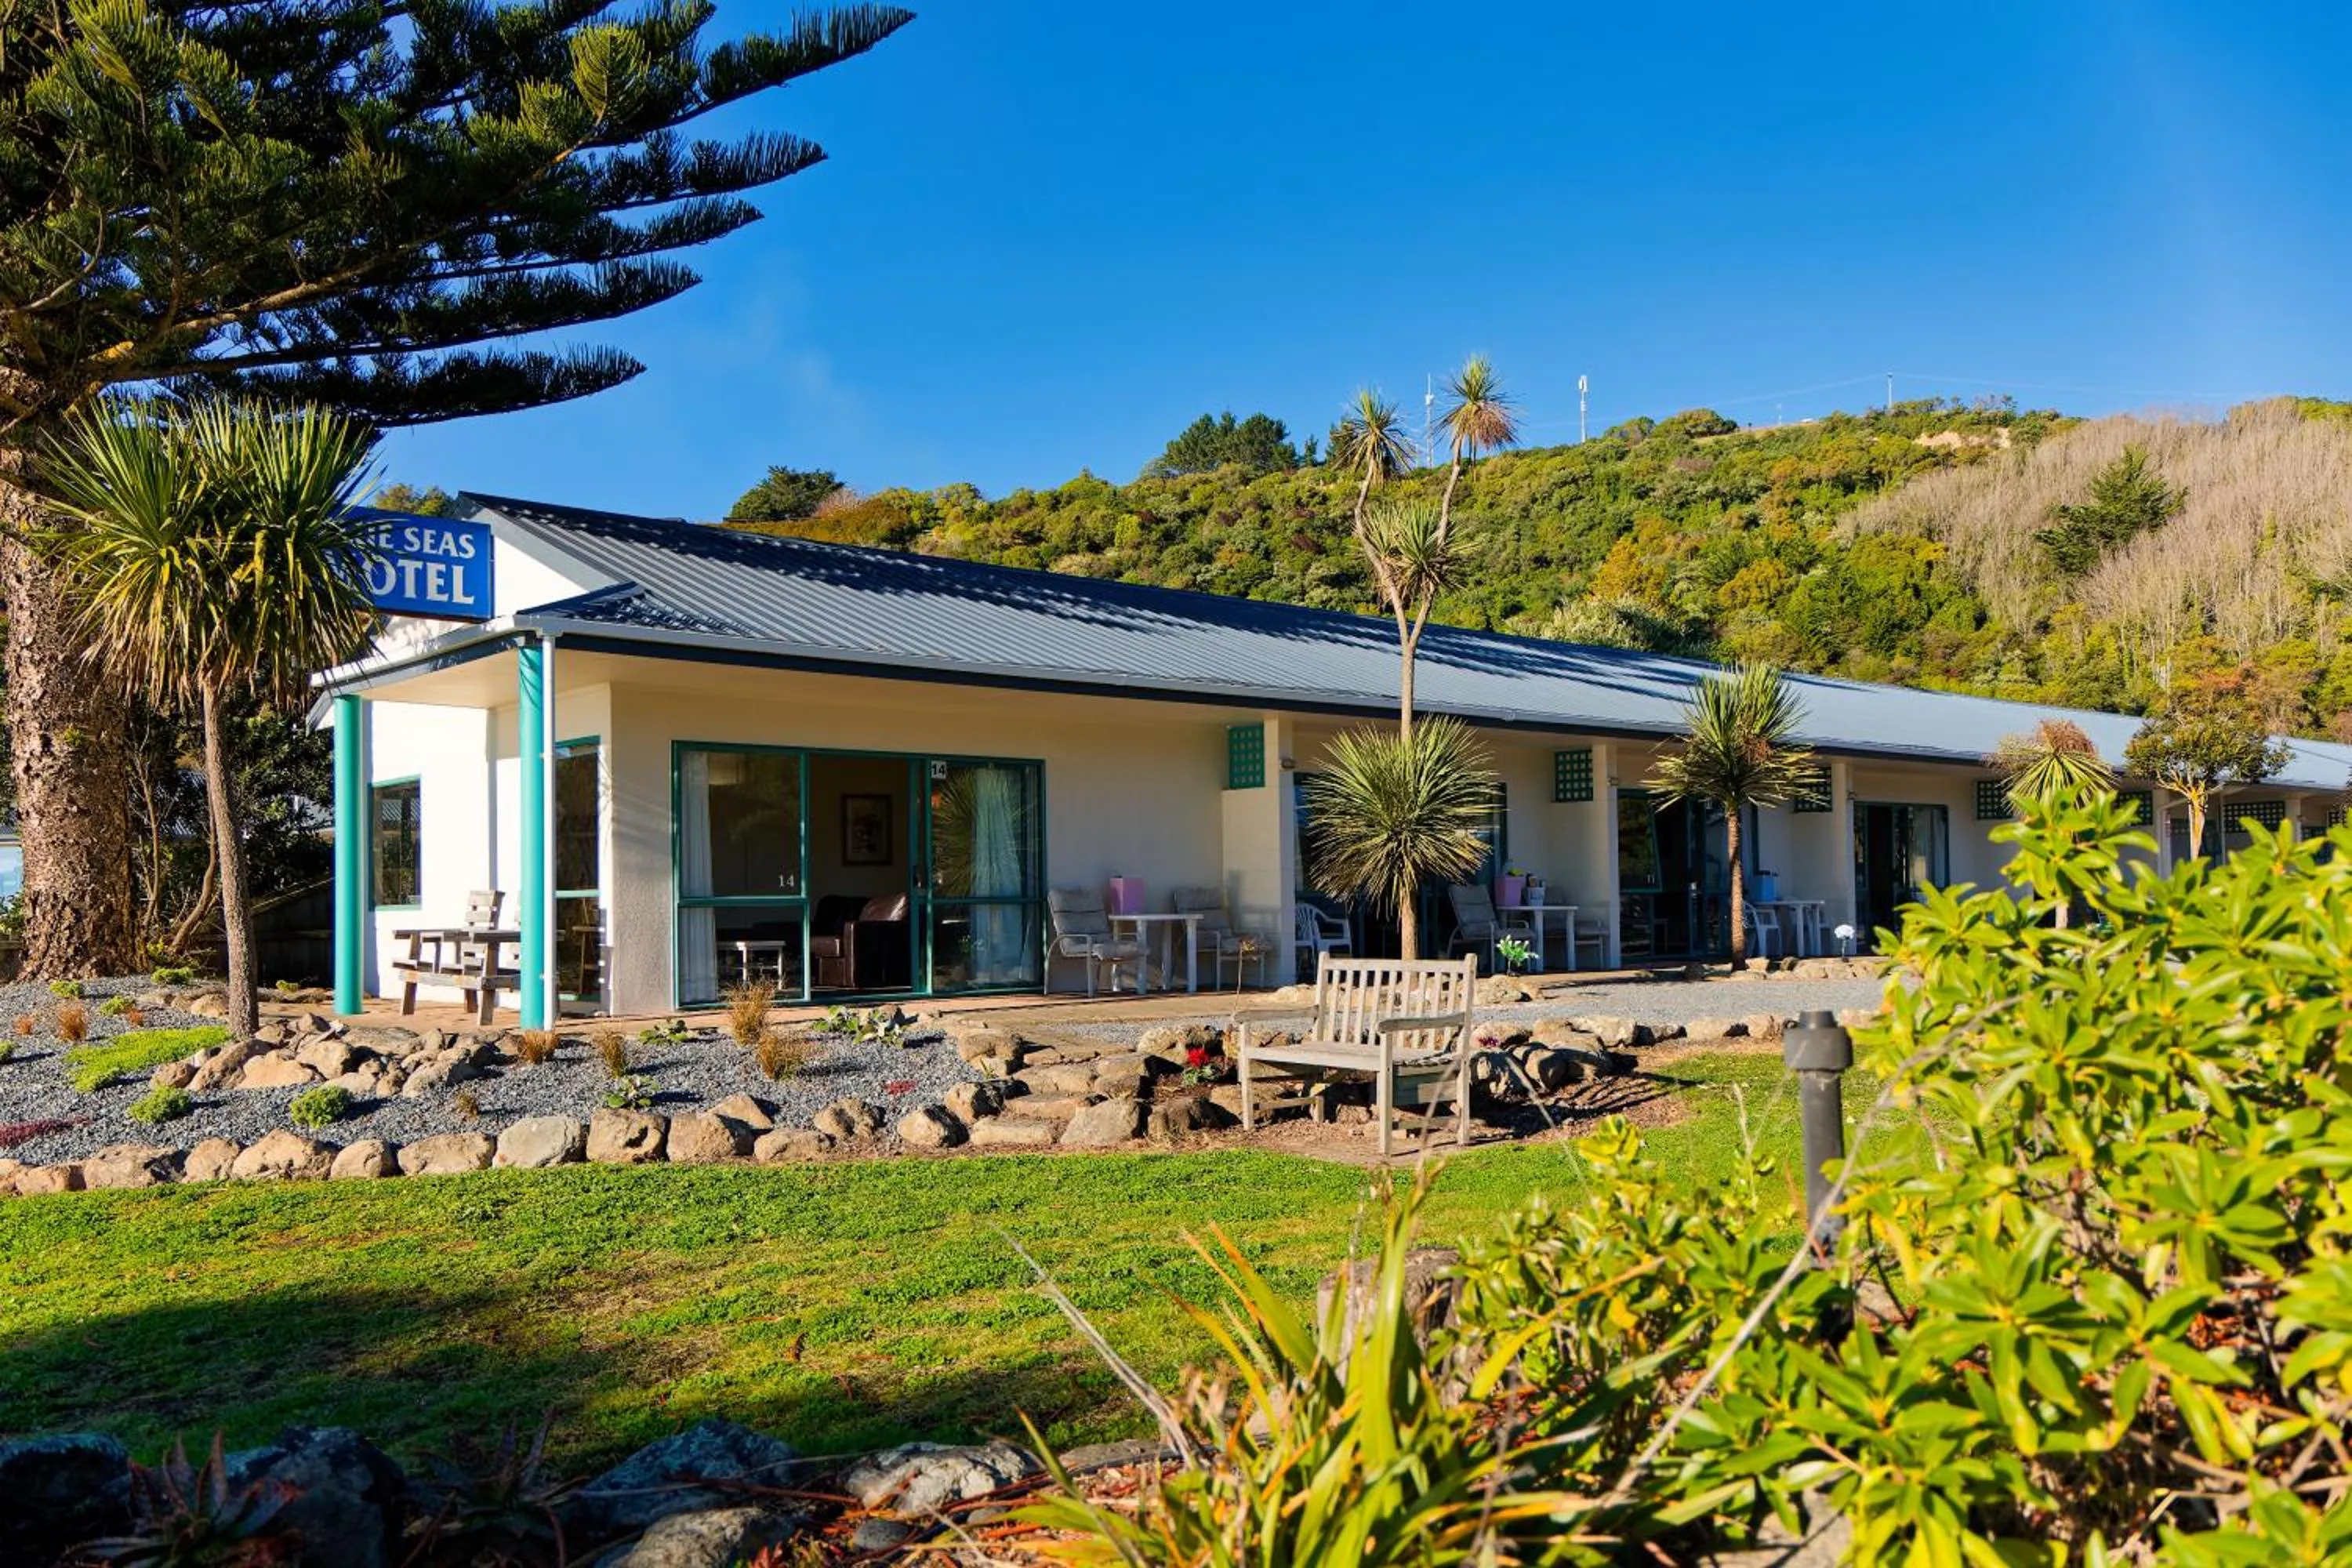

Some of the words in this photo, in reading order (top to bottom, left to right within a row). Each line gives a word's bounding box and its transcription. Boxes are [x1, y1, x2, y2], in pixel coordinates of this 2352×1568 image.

[404, 526, 475, 559] SEAS
[325, 550, 474, 604] OTEL
[931, 763, 946, 775] 14
[779, 874, 794, 887] 14
